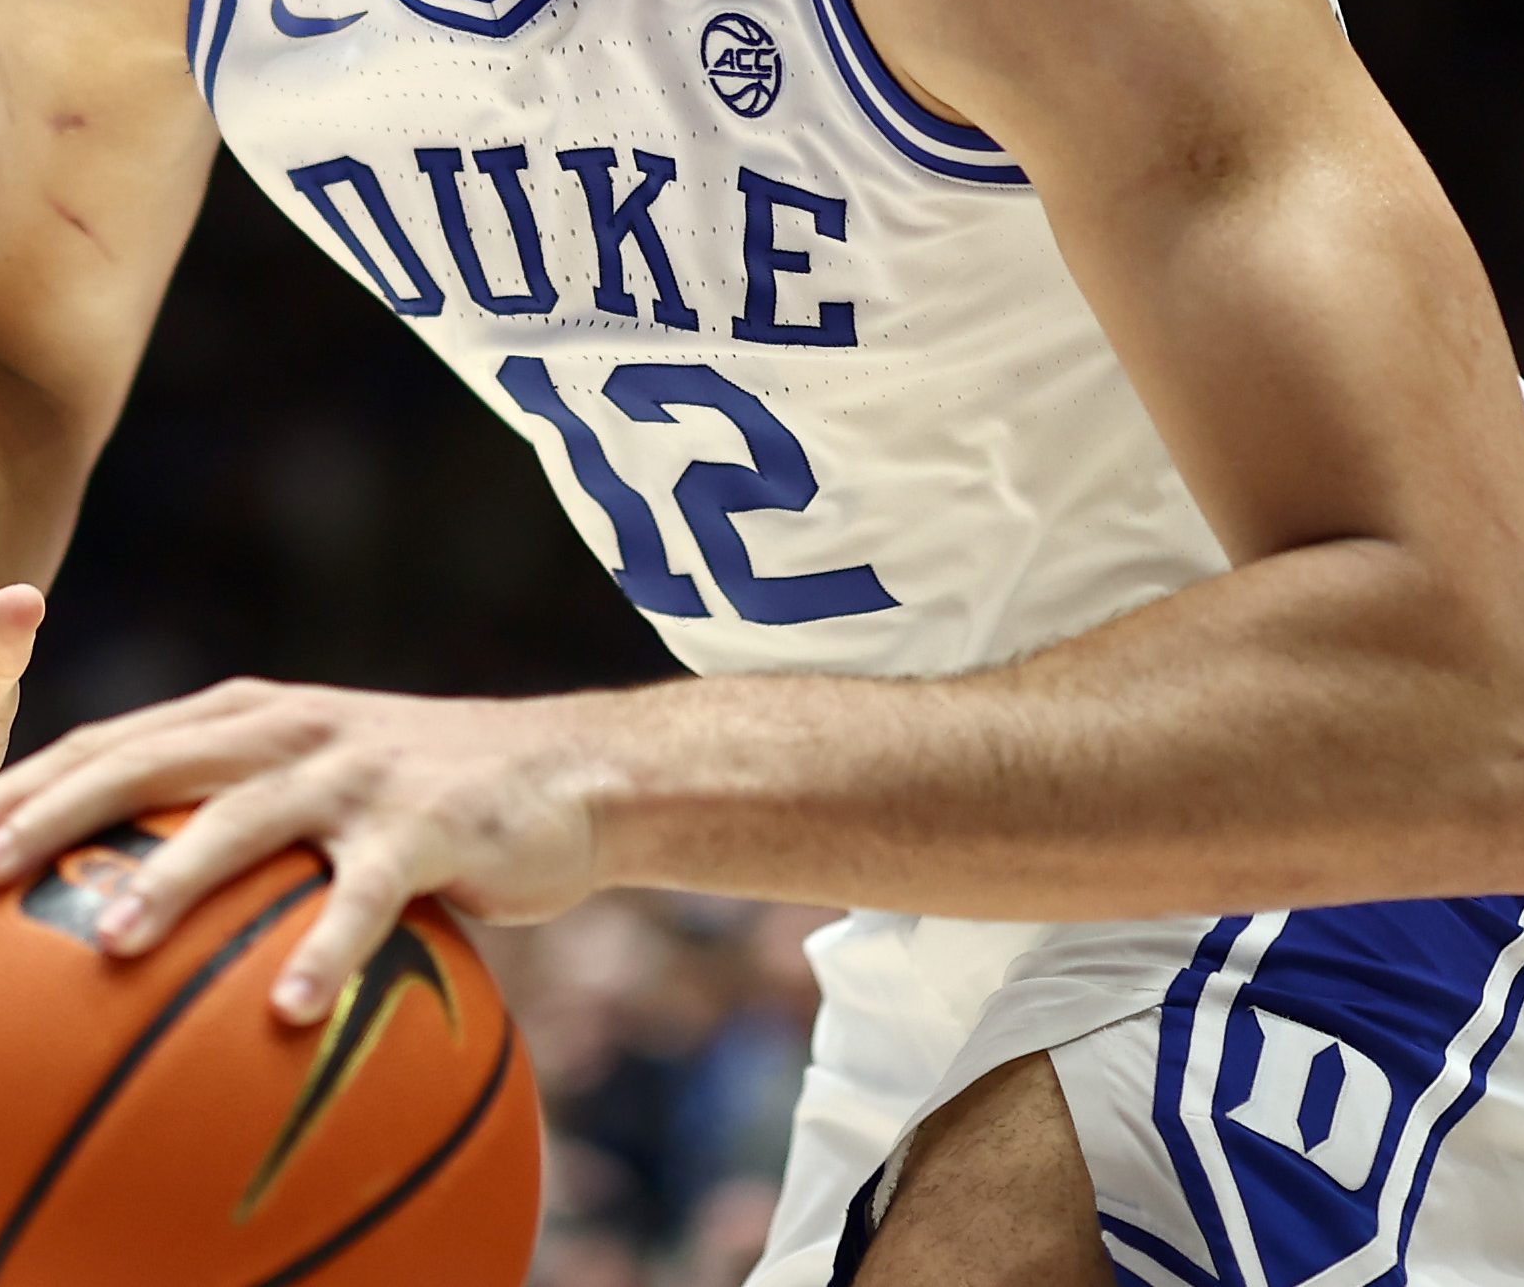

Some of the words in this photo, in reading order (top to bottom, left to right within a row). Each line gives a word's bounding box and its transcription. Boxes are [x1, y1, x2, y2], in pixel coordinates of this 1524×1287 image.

[713, 47, 776, 73] ACC
[286, 144, 859, 348] DUKE
[495, 355, 903, 626] 12
[1225, 1005, 1394, 1192] D
